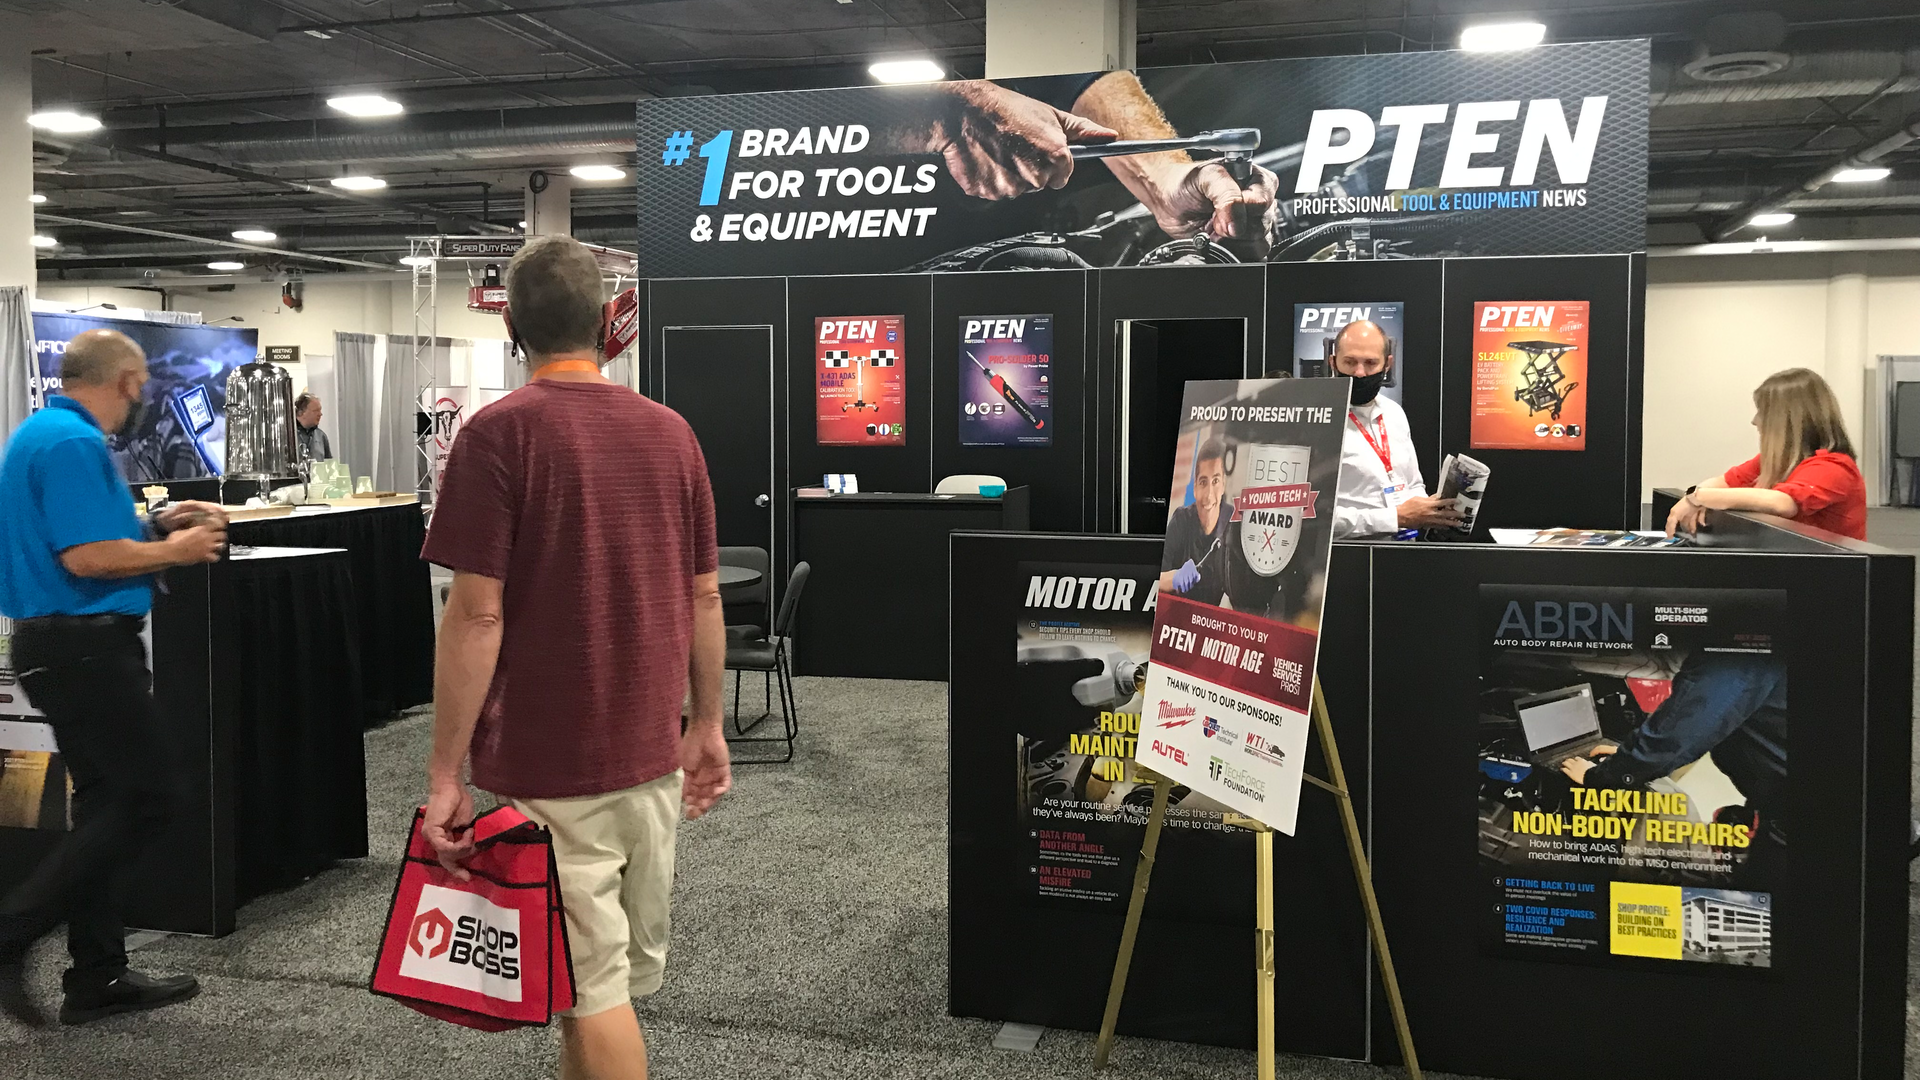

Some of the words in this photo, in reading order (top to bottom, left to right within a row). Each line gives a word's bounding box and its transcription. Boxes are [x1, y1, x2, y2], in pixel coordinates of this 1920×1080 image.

[738, 124, 870, 158] BRAND
[1294, 95, 1609, 194] PTEN
[728, 170, 806, 200] FOR
[815, 163, 938, 198] TOOLS
[1293, 195, 1398, 216] PROFESSIONAL
[1400, 193, 1437, 212] TOOL
[1439, 194, 1450, 211] &
[1453, 190, 1539, 212] EQUIPMENT
[1543, 188, 1587, 208] NEWS
[690, 214, 714, 242] &
[718, 207, 937, 242] EQUIPMENT
[1300, 307, 1371, 328] PTEN
[1480, 306, 1555, 327] PTEN
[820, 320, 878, 340] PTEN
[964, 319, 1026, 339] PTEN
[1478, 352, 1516, 360] SL24EVT
[1190, 406, 1227, 421] PROUD
[1231, 407, 1246, 422] TO
[1248, 407, 1303, 423] PRESENT
[1306, 407, 1333, 423] THE
[1254, 459, 1301, 483] BEST
[1248, 491, 1277, 506] YOUNG
[1278, 489, 1301, 503] TECH
[1249, 510, 1294, 529] AWARD
[1025, 575, 1137, 612] MOTOR
[1142, 579, 1160, 612] A
[1495, 600, 1633, 641] ABRN
[1654, 606, 1708, 614] MULTI-SHOP
[1654, 614, 1708, 623] OPERATOR
[1191, 614, 1226, 632] BROUGHT
[1228, 623, 1239, 636] TO
[1240, 626, 1256, 641] YOU
[1257, 631, 1269, 644] BY
[1158, 624, 1197, 654] PTEN
[1200, 637, 1240, 667] MOTOR
[1239, 649, 1265, 674] AGE
[1586, 642, 1633, 650] NETWORK
[1274, 657, 1303, 674] VEHICLE
[1272, 668, 1302, 686] SERVICE
[1158, 699, 1196, 720] Milwaukee
[1166, 676, 1190, 694] THANK
[1191, 685, 1206, 699] YOU
[1208, 691, 1218, 703] TO
[1219, 695, 1236, 710] OUR
[1237, 702, 1283, 727] SPONSORS!
[1100, 711, 1141, 734] ROU
[1070, 733, 1138, 758] MAINT
[1246, 732, 1266, 749] WTI
[1152, 739, 1188, 766] AUTEL
[1104, 761, 1124, 782] IN
[1223, 778, 1265, 803] FOUNDATION
[1043, 797, 1058, 806] Are
[1060, 799, 1079, 809] your
[1081, 801, 1111, 811] routine
[1113, 803, 1144, 813] service
[1192, 809, 1207, 819] the
[1570, 787, 1687, 816] TACKLING
[1032, 808, 1062, 818] they've
[1064, 810, 1094, 821] always
[1096, 813, 1122, 822] been?
[1170, 818, 1190, 828] time
[1192, 820, 1201, 829] to
[1040, 830, 1060, 840] DATA
[1062, 832, 1086, 842] FROM
[1513, 811, 1637, 841] NON-BODY
[1646, 819, 1750, 848] REPAIRS
[1040, 840, 1076, 851] ANOTHER
[1079, 844, 1104, 854] ANGLE
[1530, 839, 1550, 849] How
[1553, 840, 1562, 849] to
[1564, 841, 1588, 853] bring
[1590, 843, 1618, 854] ADAS,
[1666, 848, 1710, 858] electrical
[1713, 850, 1732, 860] and
[1040, 866, 1050, 875] AN
[1053, 867, 1092, 878] ELEVATED
[1528, 852, 1580, 862] mechanical
[1582, 855, 1606, 864] work
[1608, 856, 1626, 865] into
[1628, 858, 1644, 866] the
[1646, 859, 1668, 868] MSO
[1670, 861, 1732, 872] environment
[1040, 876, 1072, 887] MISFIRE
[1505, 878, 1538, 888] GETTING
[1541, 880, 1562, 890] BACK
[1565, 882, 1576, 891] TO
[1578, 884, 1595, 892] LIVE
[1506, 904, 1523, 913] TWO
[1526, 906, 1548, 915] COVID
[1550, 908, 1597, 919] RESPONSES:
[1506, 914, 1547, 925] RESILIENCE
[1549, 917, 1565, 926] AND
[1617, 903, 1637, 914] SHOP
[1638, 905, 1670, 916] PROFILE:
[1617, 913, 1652, 926] BUILDING
[1654, 917, 1664, 926] ON
[455, 915, 518, 953] SHOP
[1506, 924, 1553, 935] REALIZATION
[1617, 925, 1635, 936] BEST
[1637, 926, 1677, 939] PRACTICES
[449, 940, 521, 980] BOSS
